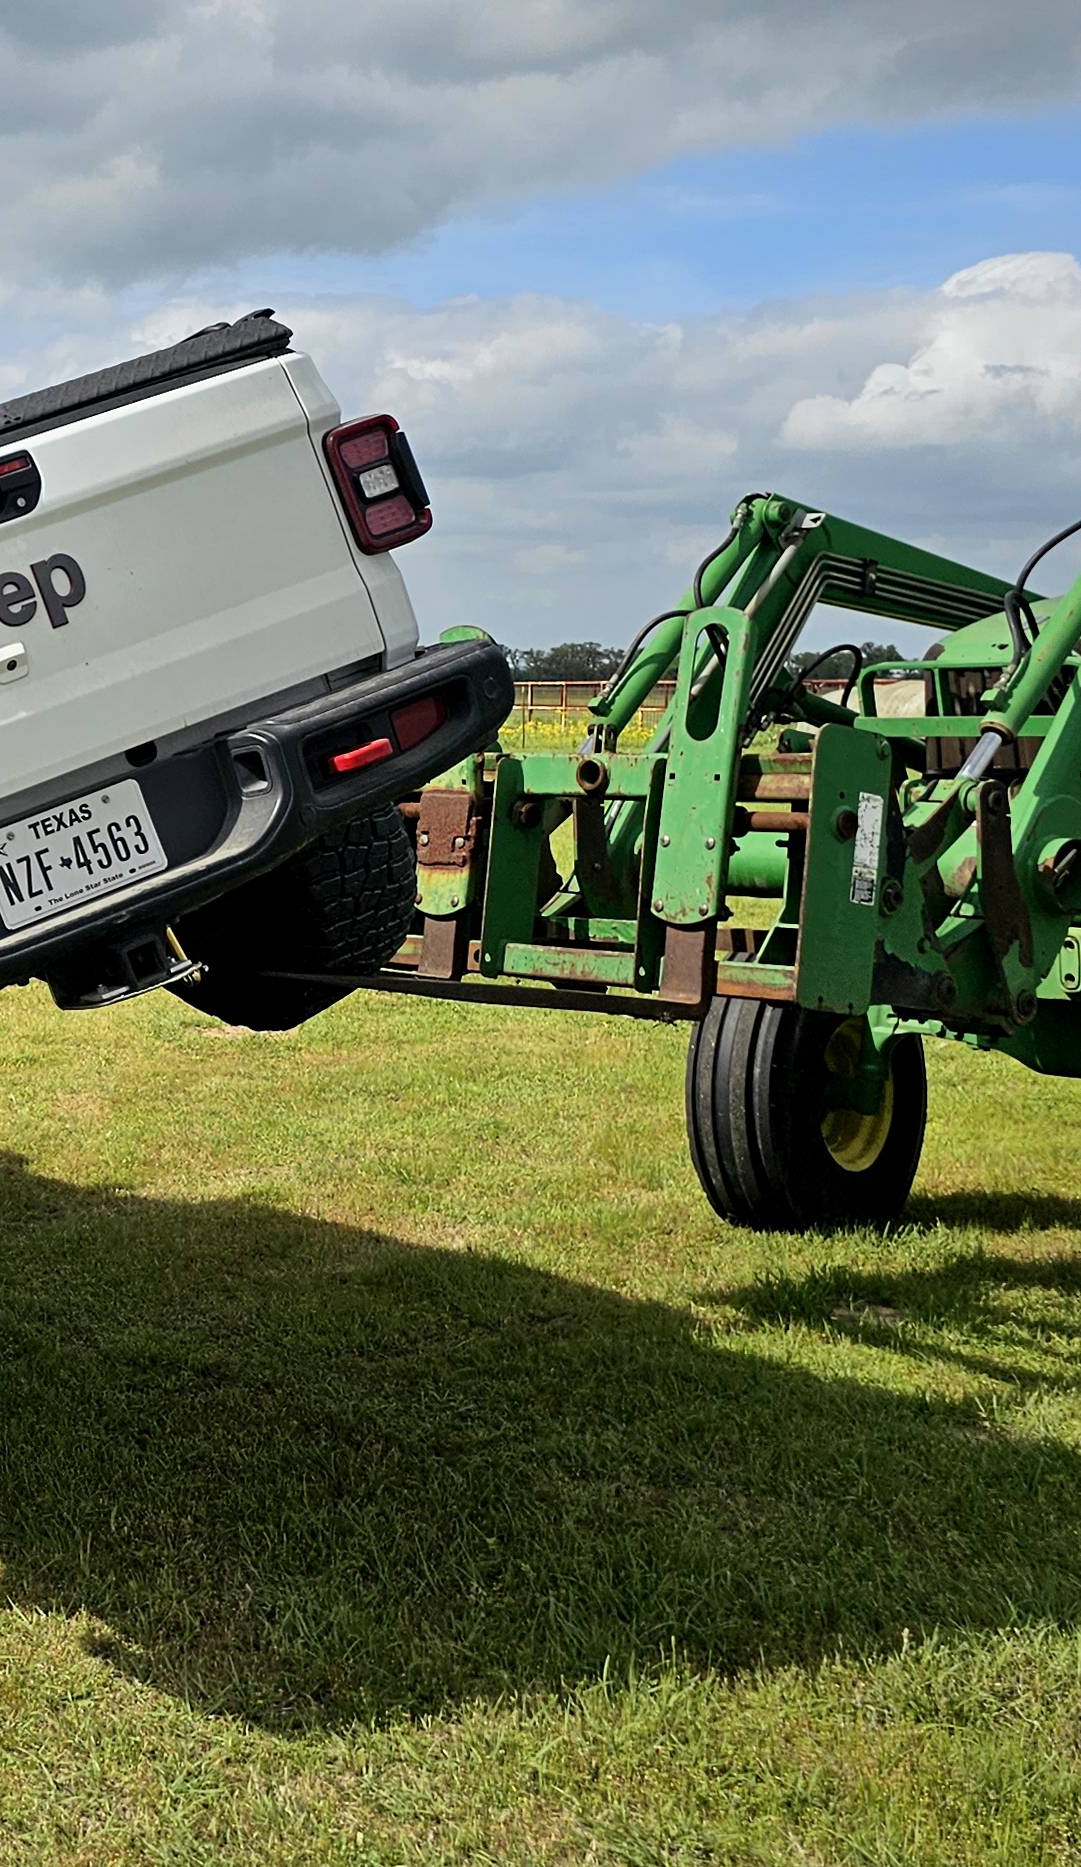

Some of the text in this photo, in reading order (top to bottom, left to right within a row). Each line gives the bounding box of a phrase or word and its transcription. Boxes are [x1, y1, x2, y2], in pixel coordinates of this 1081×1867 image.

[27, 803, 92, 839] TEXAS
[72, 814, 149, 875] 4563
[48, 873, 123, 905] The Lone Star State
